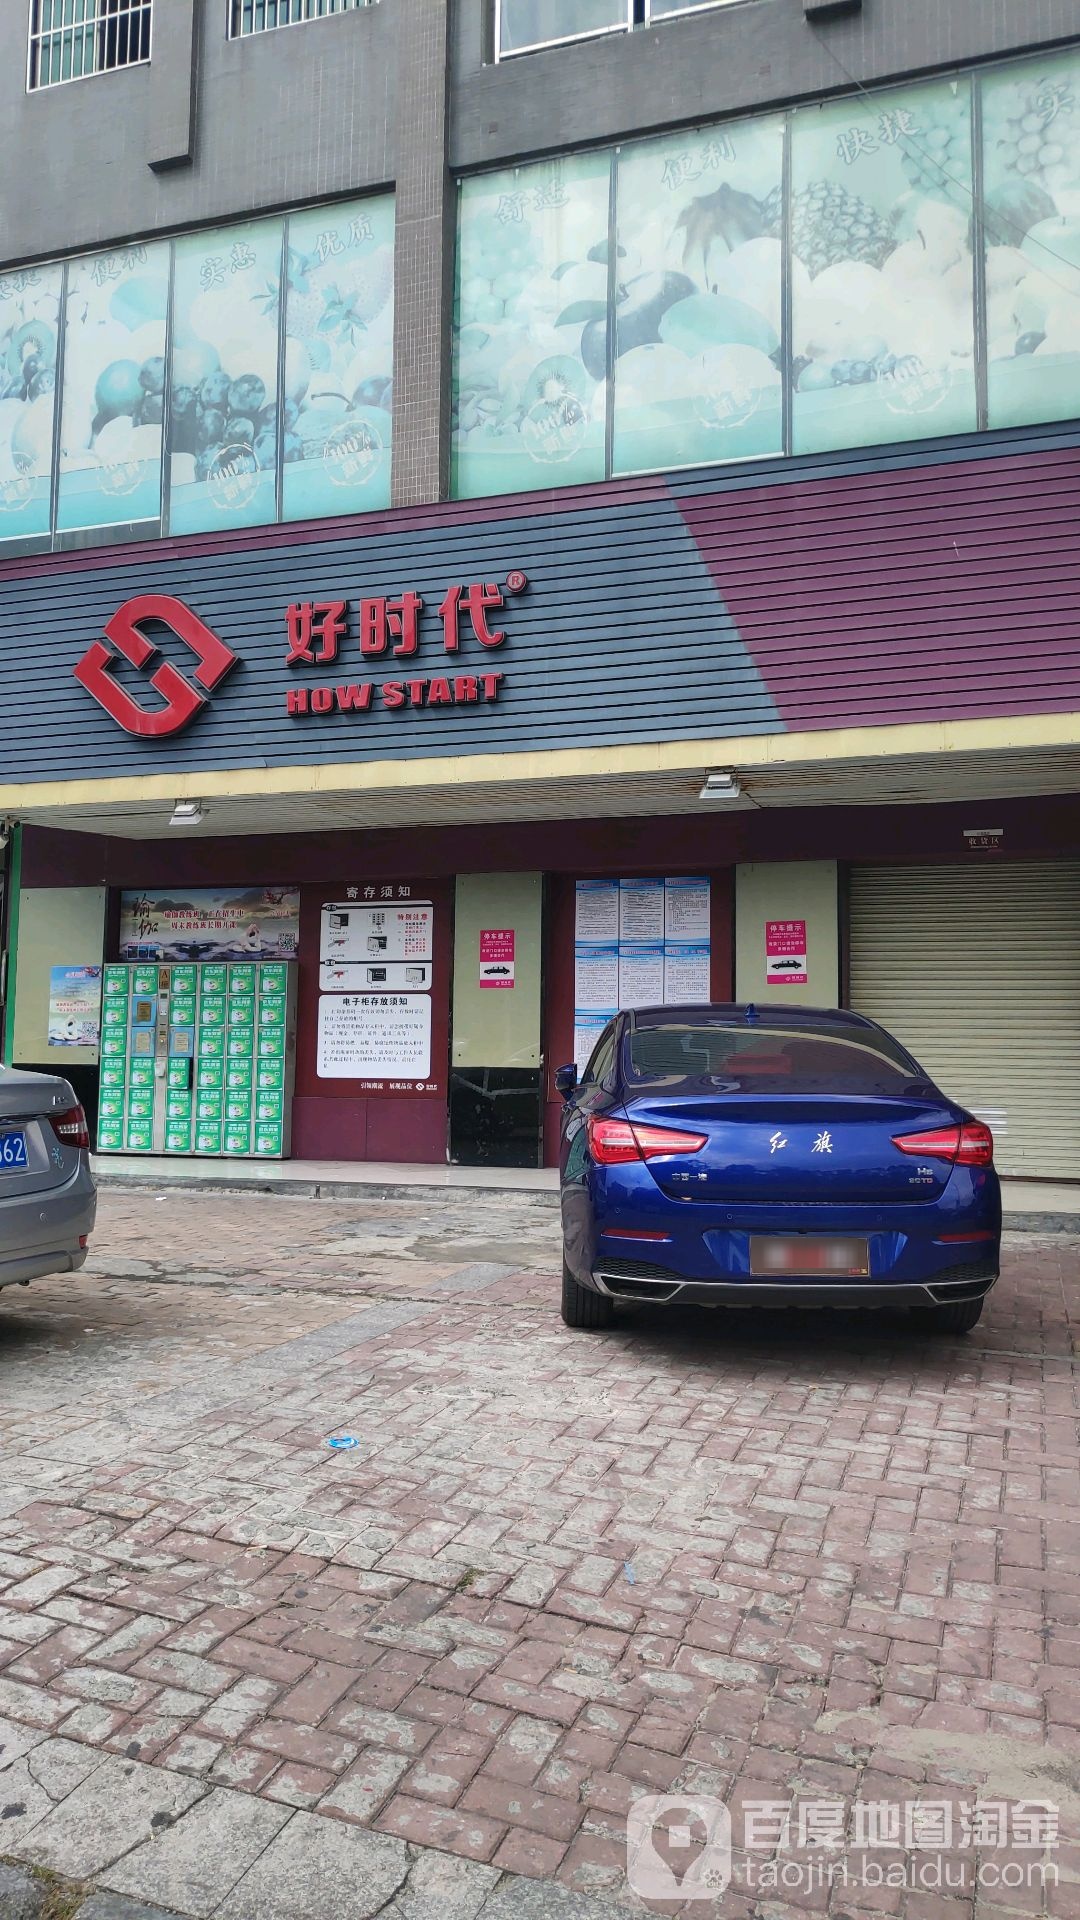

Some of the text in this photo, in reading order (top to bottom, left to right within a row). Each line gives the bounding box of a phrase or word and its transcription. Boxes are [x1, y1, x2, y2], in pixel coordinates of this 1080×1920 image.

[837, 109, 921, 165] 快捷
[661, 134, 736, 191] 便利
[497, 178, 570, 225] 舒适
[313, 213, 374, 262] 优质
[200, 242, 256, 292] 实惠
[285, 583, 506, 666] 好时代
[287, 673, 502, 716] HOW START
[346, 886, 411, 899] 寄存须知
[342, 997, 408, 1006] 电子柜存放须知
[770, 1131, 833, 1153] 红旗
